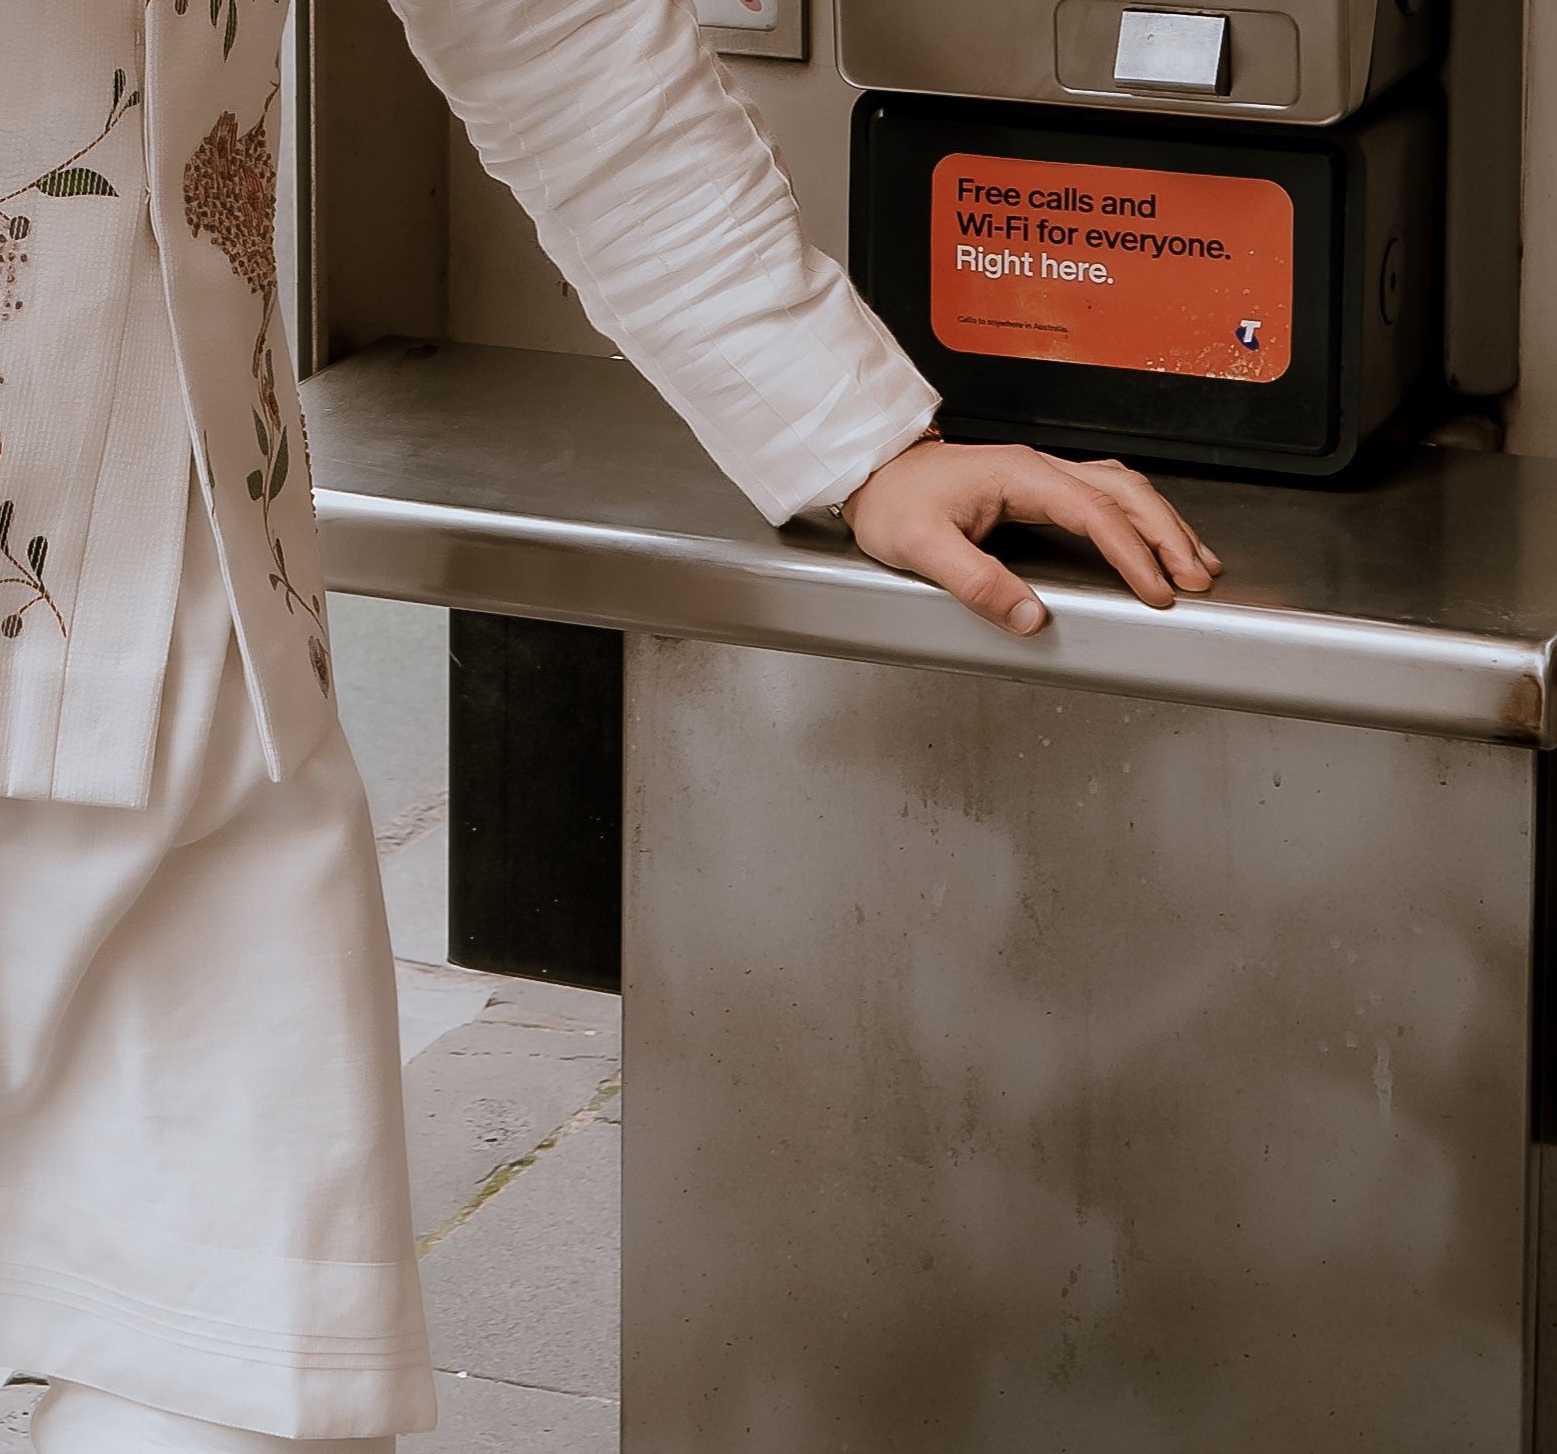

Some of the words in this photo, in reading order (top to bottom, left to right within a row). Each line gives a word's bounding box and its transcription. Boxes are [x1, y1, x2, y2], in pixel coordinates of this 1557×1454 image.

[958, 177, 1021, 207] Free
[1028, 187, 1094, 214] calls
[1101, 193, 1158, 219] and
[956, 211, 1030, 242] Wi-Fi
[1036, 217, 1080, 246] for
[1085, 228, 1233, 261] everyone.
[956, 244, 1034, 281] Right
[1040, 250, 1115, 285] here.
